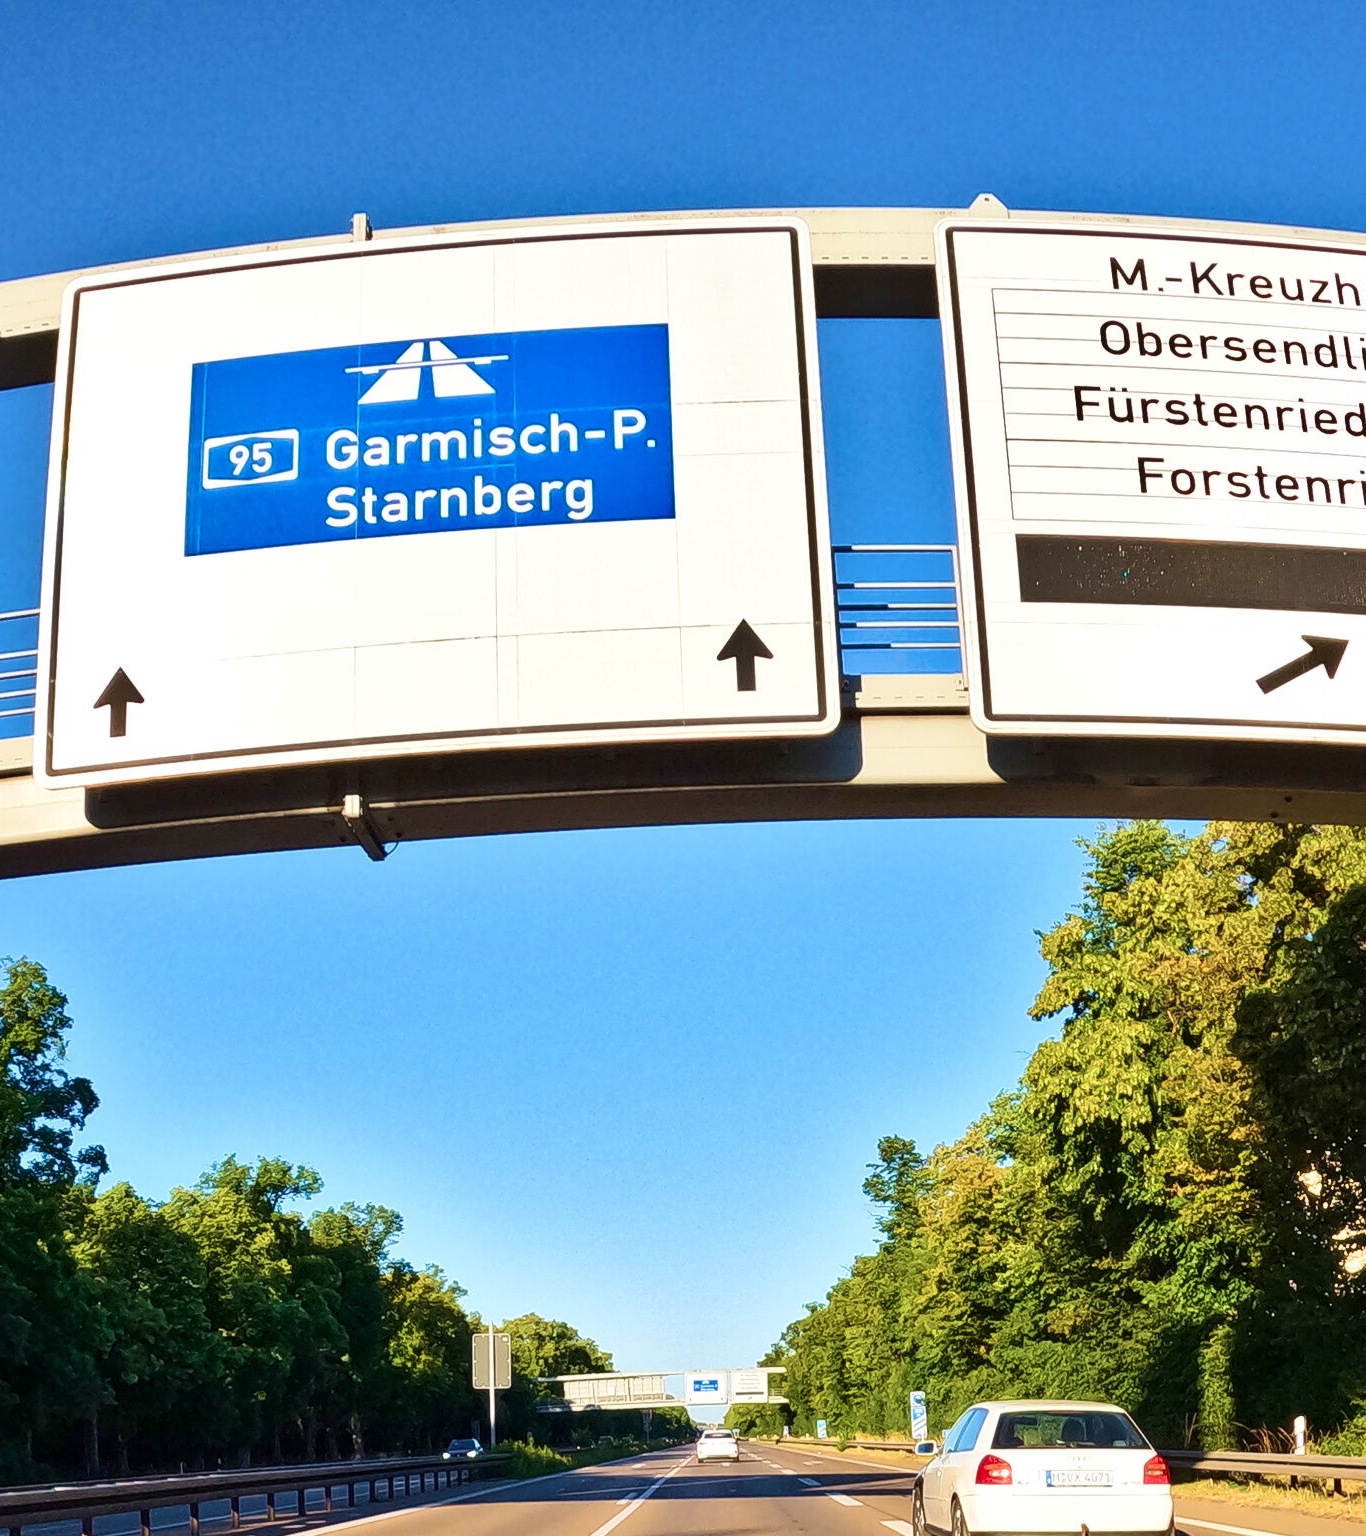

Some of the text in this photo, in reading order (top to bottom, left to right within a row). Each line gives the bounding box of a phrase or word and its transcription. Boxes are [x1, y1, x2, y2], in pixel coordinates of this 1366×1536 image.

[229, 442, 273, 476] 95
[325, 409, 657, 470] Garmisch-P.
[325, 475, 594, 527] Starnberg
